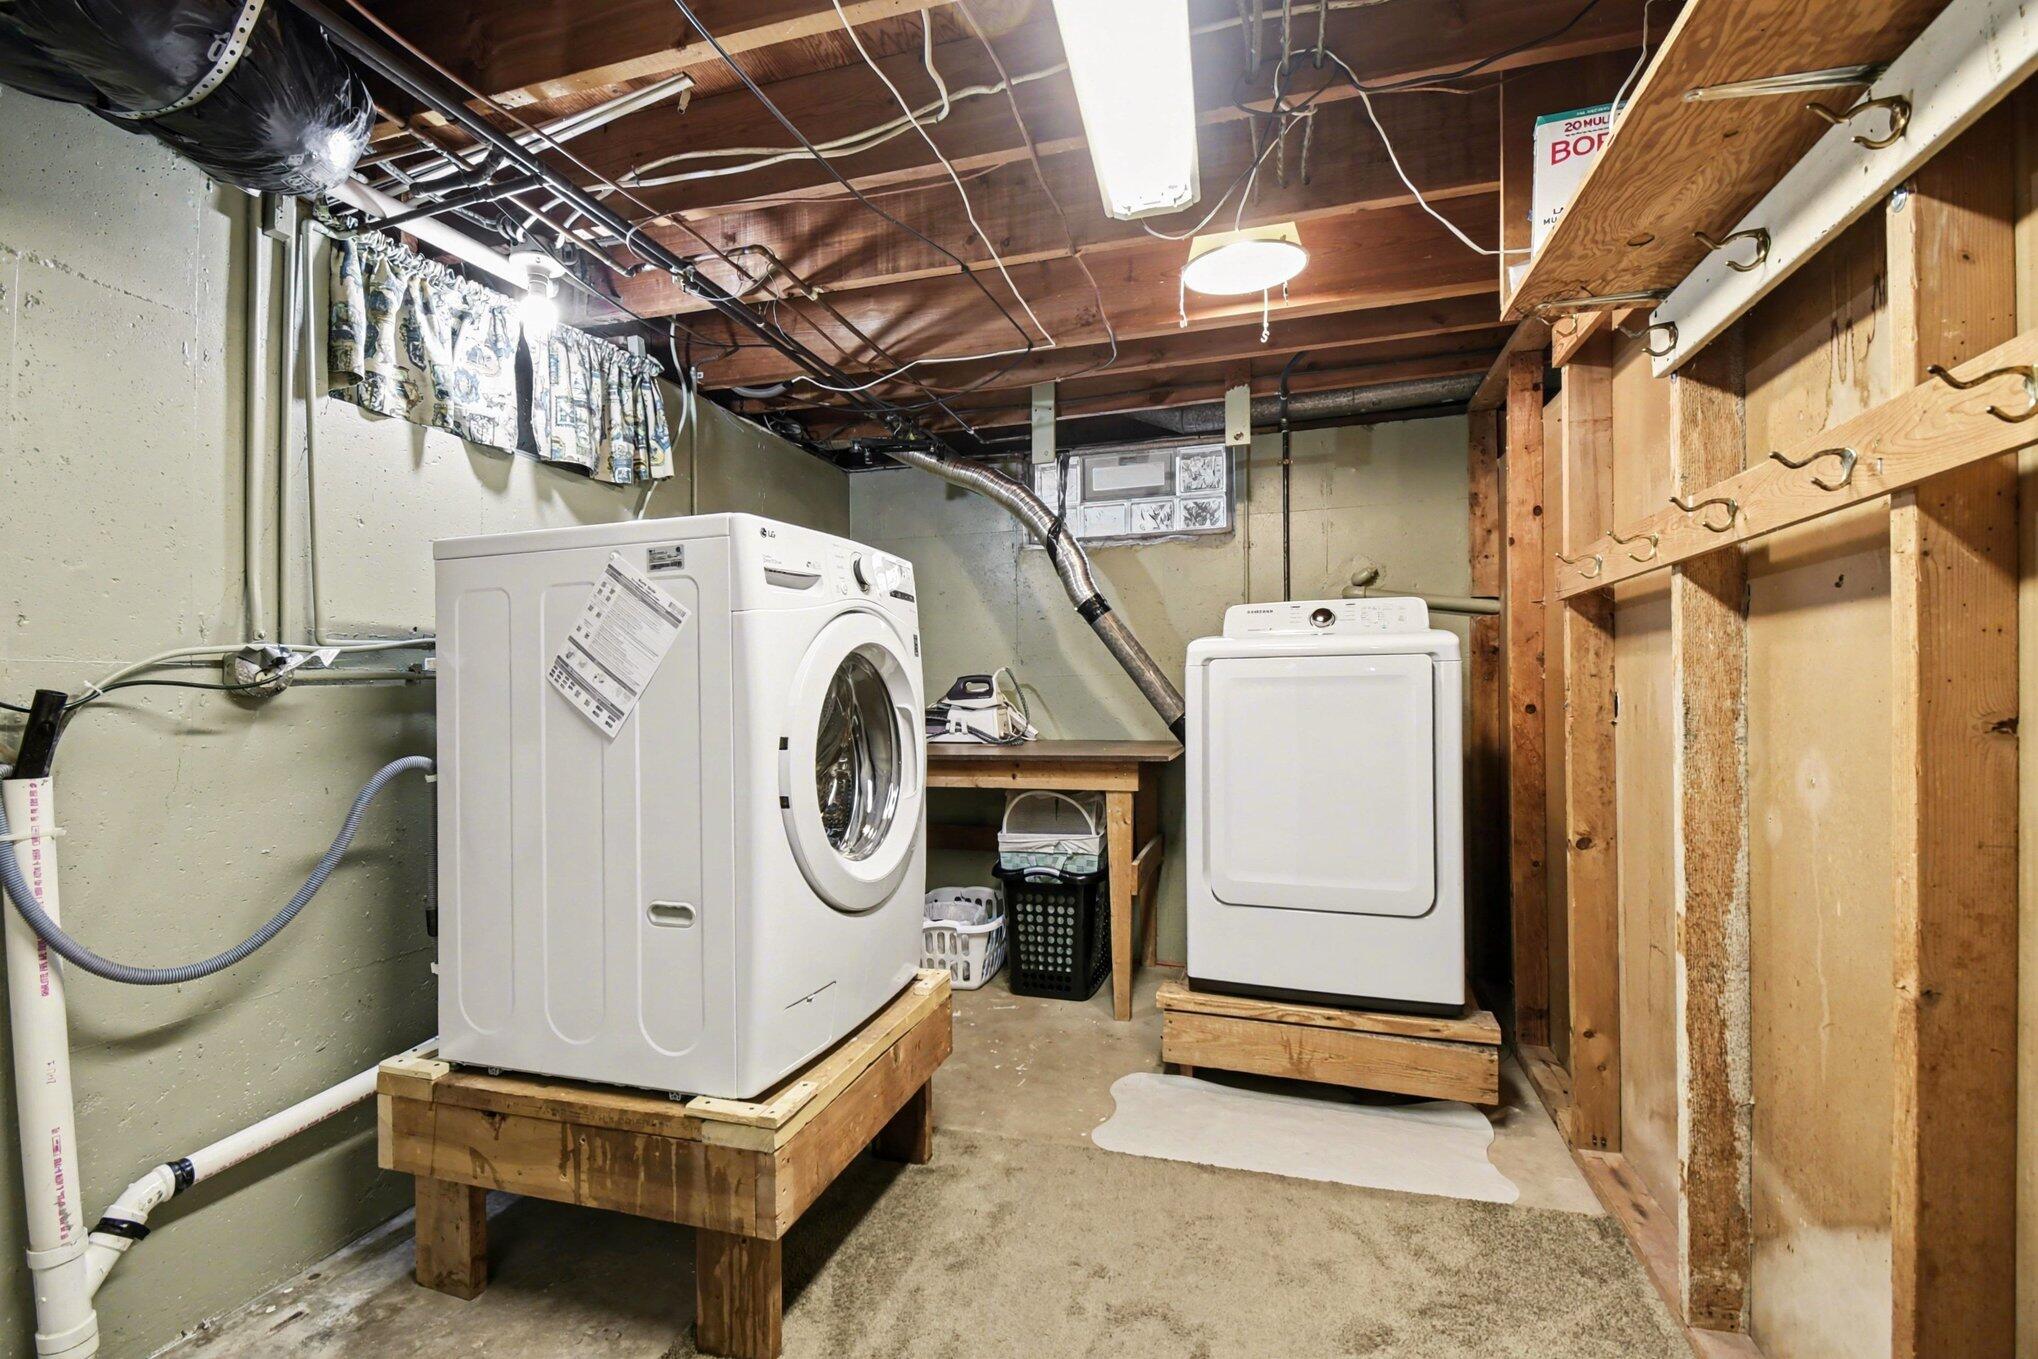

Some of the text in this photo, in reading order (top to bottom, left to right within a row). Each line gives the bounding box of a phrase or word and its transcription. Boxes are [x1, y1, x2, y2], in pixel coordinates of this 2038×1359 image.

[1564, 116, 1610, 134] 20 MUL
[1543, 216, 1558, 226] MU
